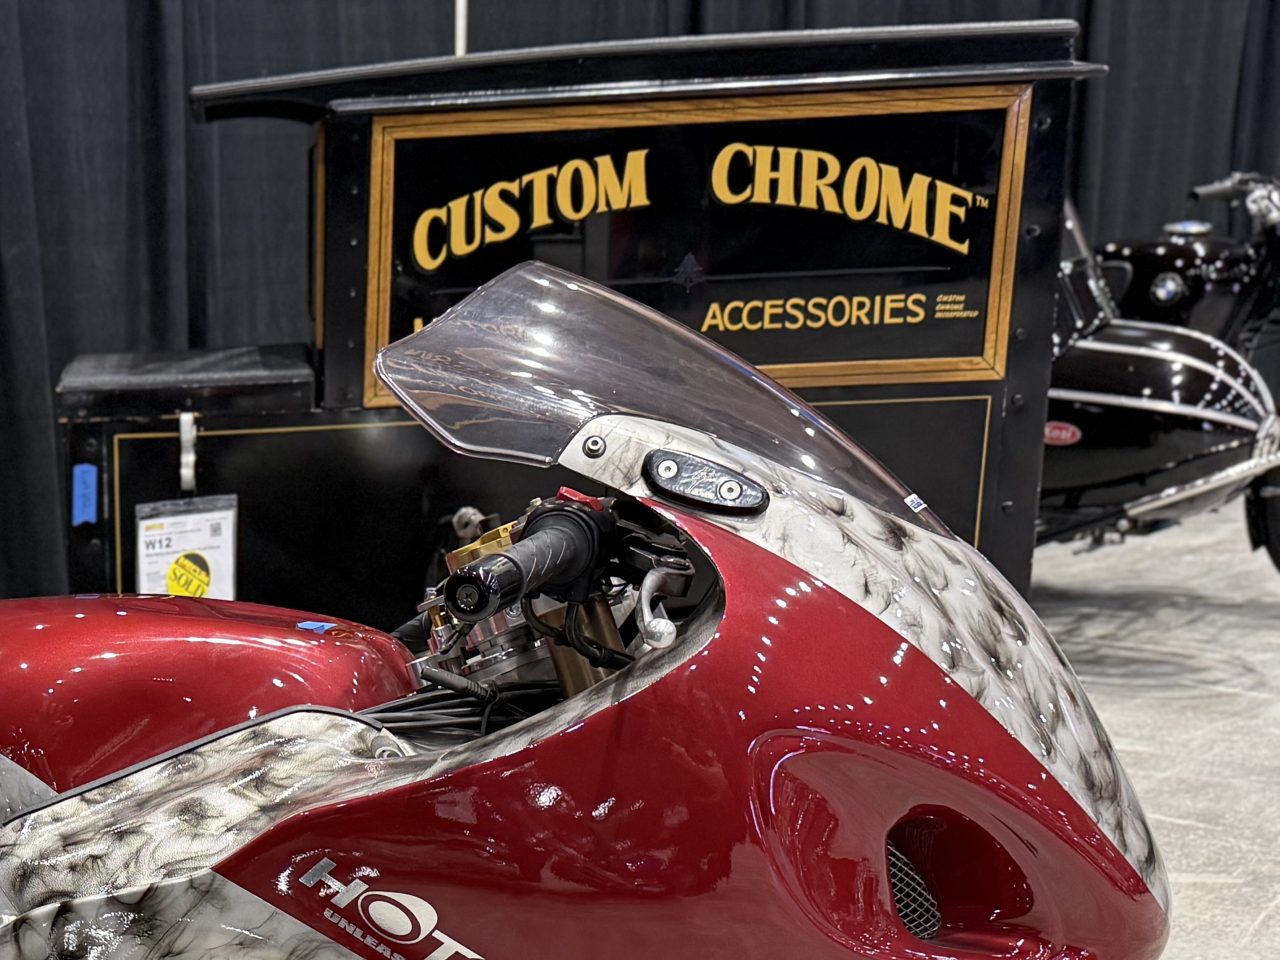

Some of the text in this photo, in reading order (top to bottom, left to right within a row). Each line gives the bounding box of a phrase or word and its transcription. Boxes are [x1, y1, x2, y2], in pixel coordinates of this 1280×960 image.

[412, 148, 649, 271] CUSTOM
[710, 141, 974, 255] CHROME
[701, 293, 926, 332] ACCESSORIES
[144, 536, 172, 551] W12
[170, 568, 205, 597] SOLD
